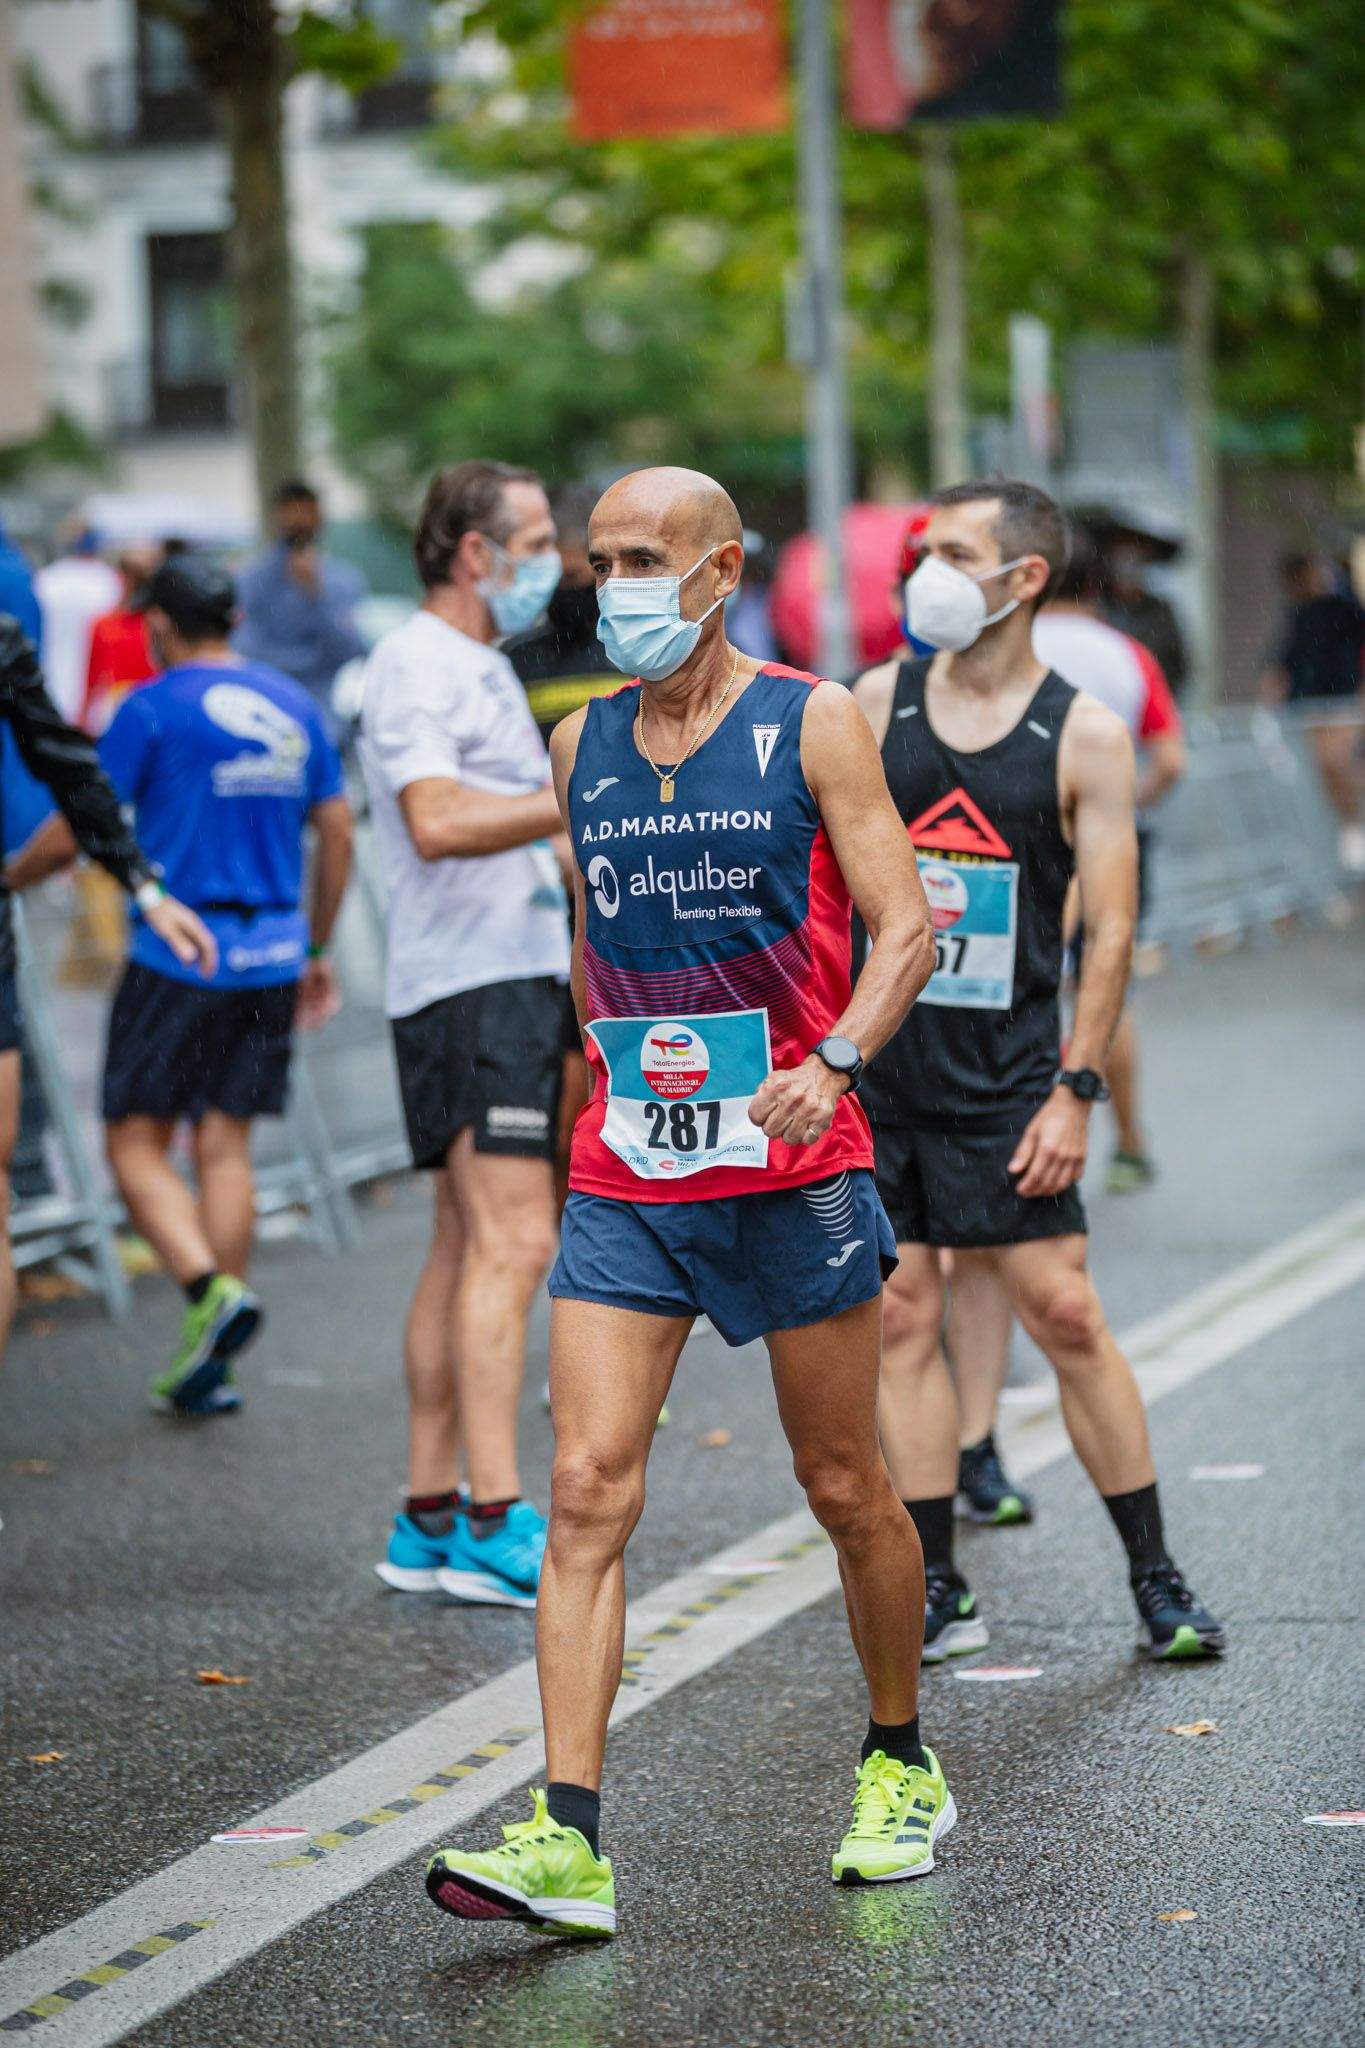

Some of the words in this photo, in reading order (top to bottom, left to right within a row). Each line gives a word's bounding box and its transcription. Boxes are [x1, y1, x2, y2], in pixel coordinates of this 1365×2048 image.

[582, 810, 772, 844] A.D.MARATHON
[629, 851, 762, 909] alquiber
[674, 908, 716, 920] Renting
[718, 906, 762, 918] Flexible
[644, 1101, 722, 1152] 287
